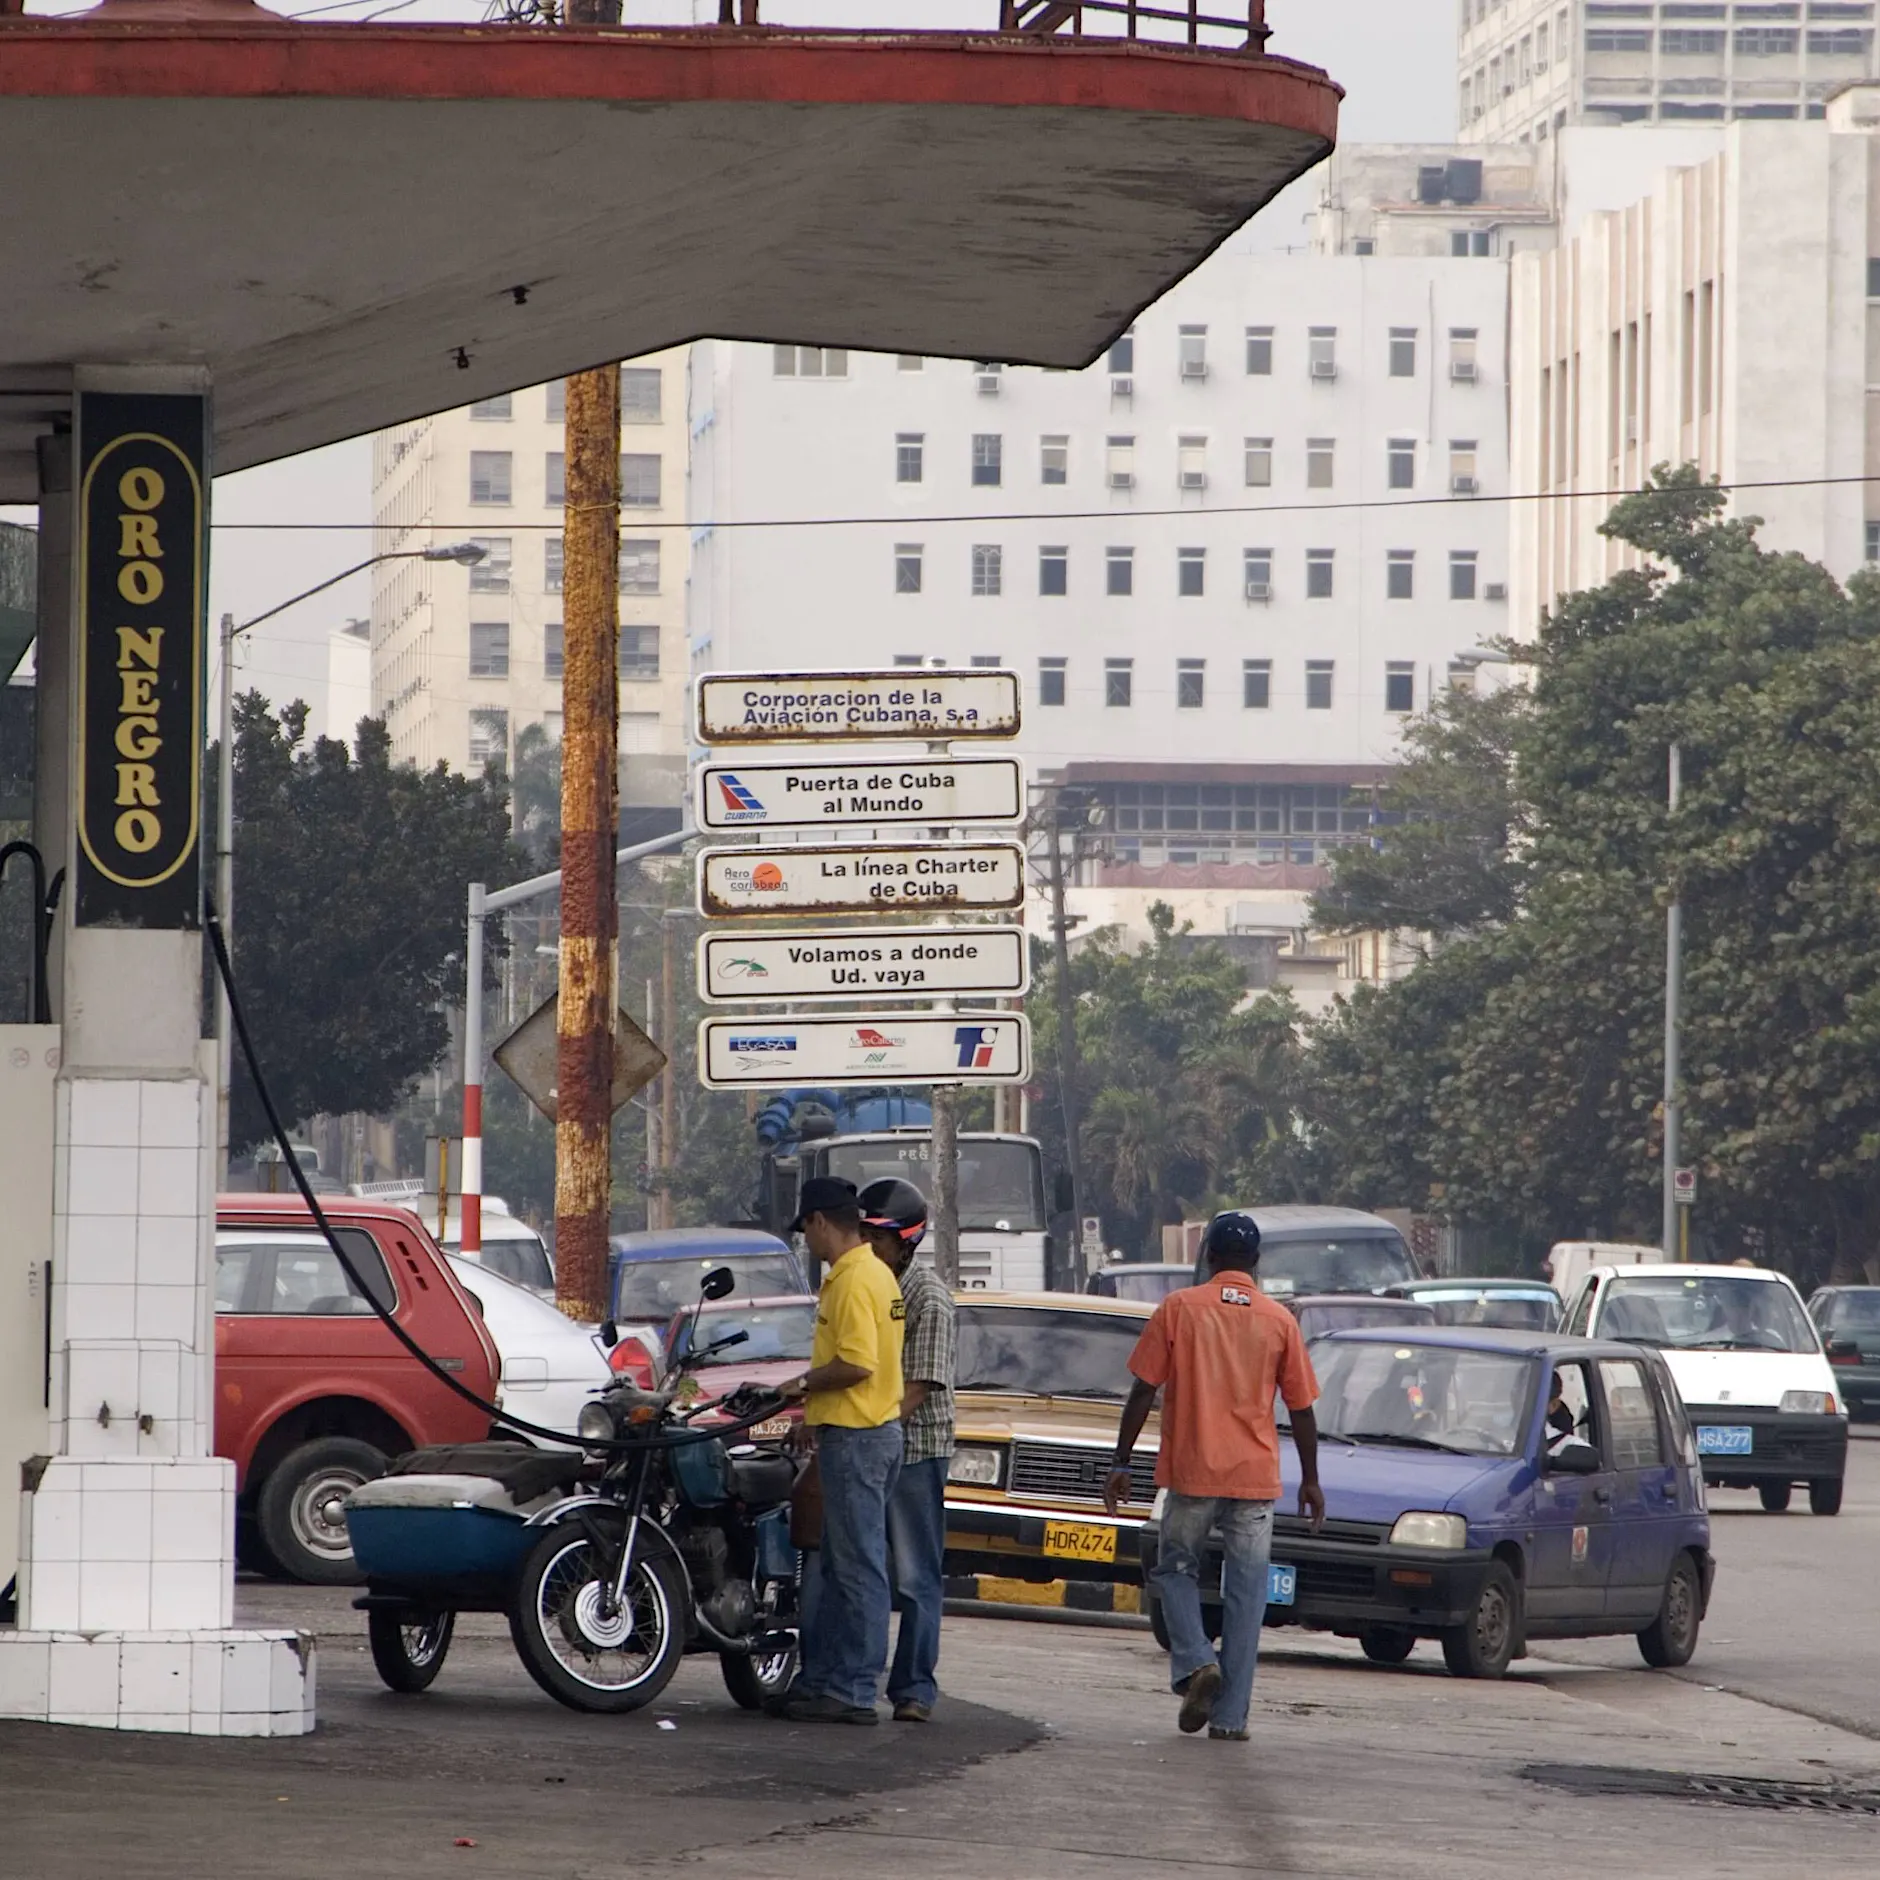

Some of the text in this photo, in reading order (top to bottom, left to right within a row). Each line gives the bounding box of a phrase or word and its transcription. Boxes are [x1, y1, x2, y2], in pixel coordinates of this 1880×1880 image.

[113, 466, 166, 854] ORO NEGRO
[743, 689, 942, 710] Corporacion de la
[743, 705, 838, 725] Aviación
[846, 706, 938, 724] Cubana,
[786, 773, 955, 792] Puerta de Cuba
[823, 796, 923, 814] al Mundo
[725, 868, 750, 879] Aero
[821, 856, 999, 877] La línea Charter
[870, 881, 958, 897] de Cuba
[788, 944, 977, 963] Volamos a donde
[831, 968, 925, 984] Ud. vaya
[1698, 1432, 1749, 1447] HSA277
[1045, 1530, 1113, 1552] HDR474
[1268, 1574, 1293, 1595] 19
